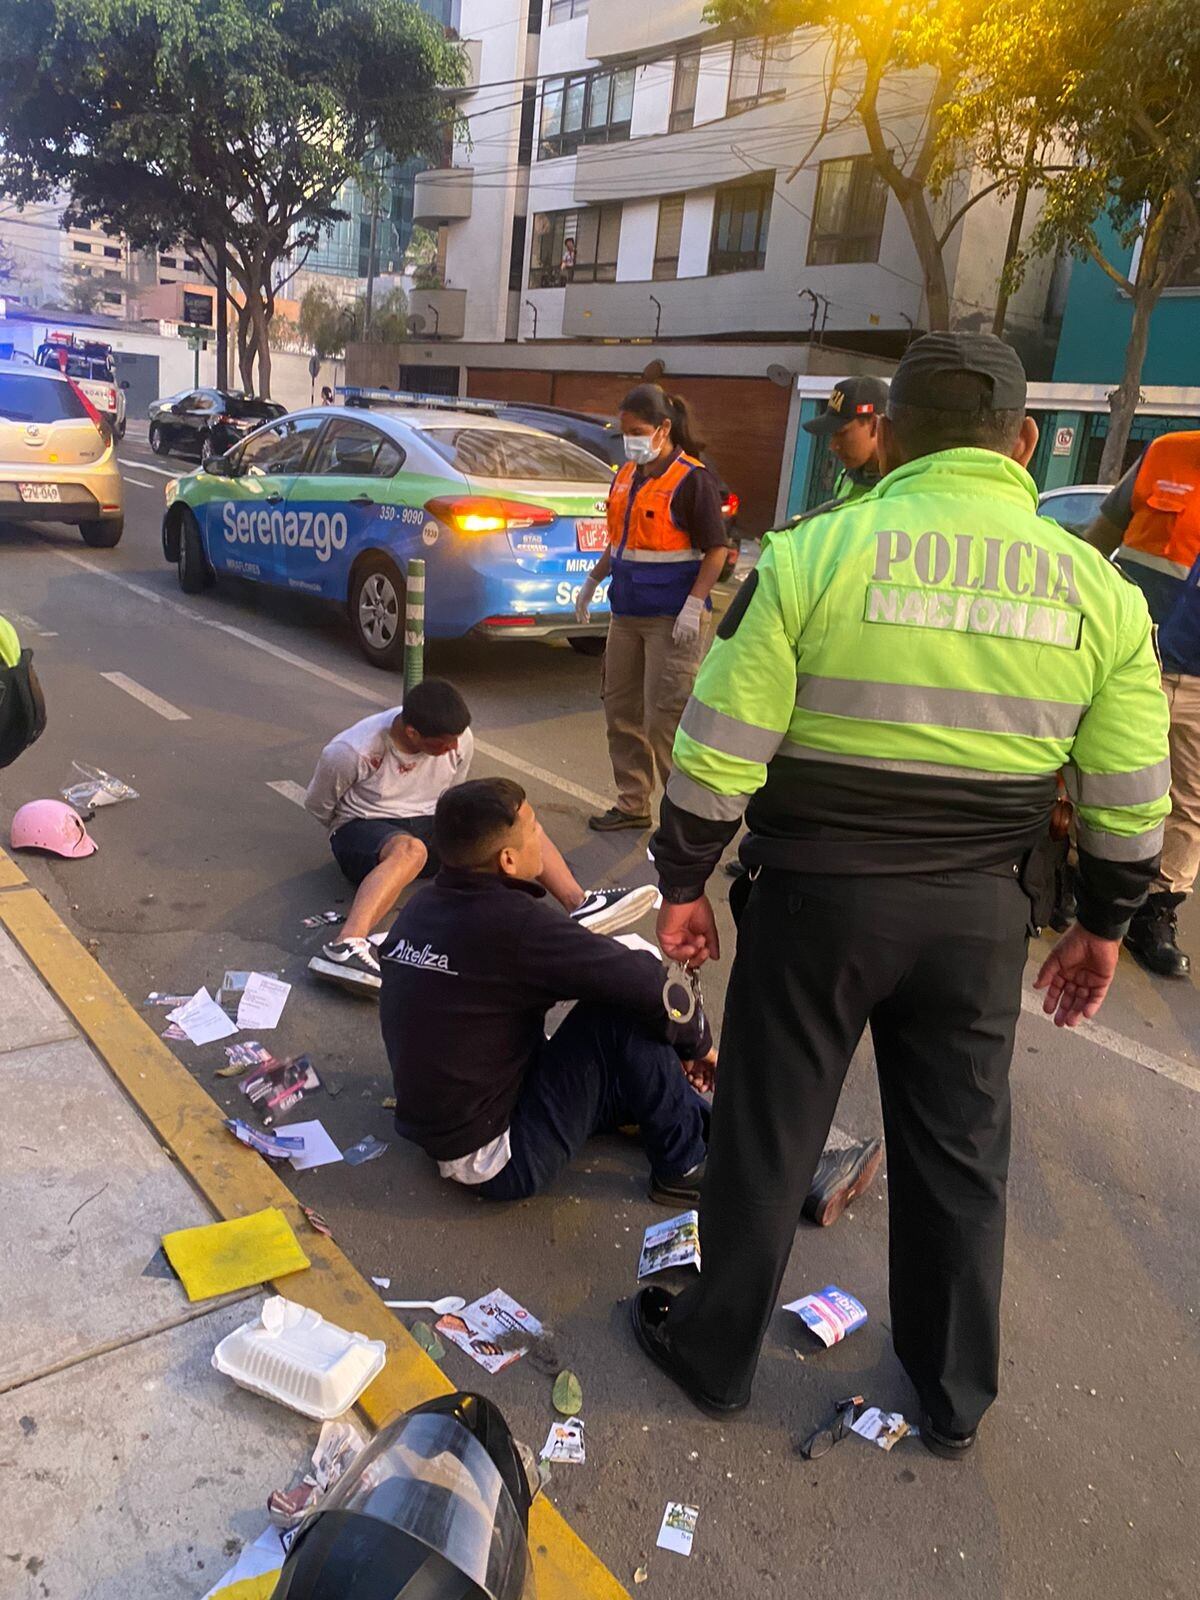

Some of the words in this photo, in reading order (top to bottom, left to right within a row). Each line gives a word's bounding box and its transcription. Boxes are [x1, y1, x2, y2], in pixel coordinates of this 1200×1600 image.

[222, 501, 348, 562] Serenazgo
[566, 559, 599, 572] MIRA
[871, 530, 1082, 605] POLICIA
[867, 588, 1075, 644] NACIONAL
